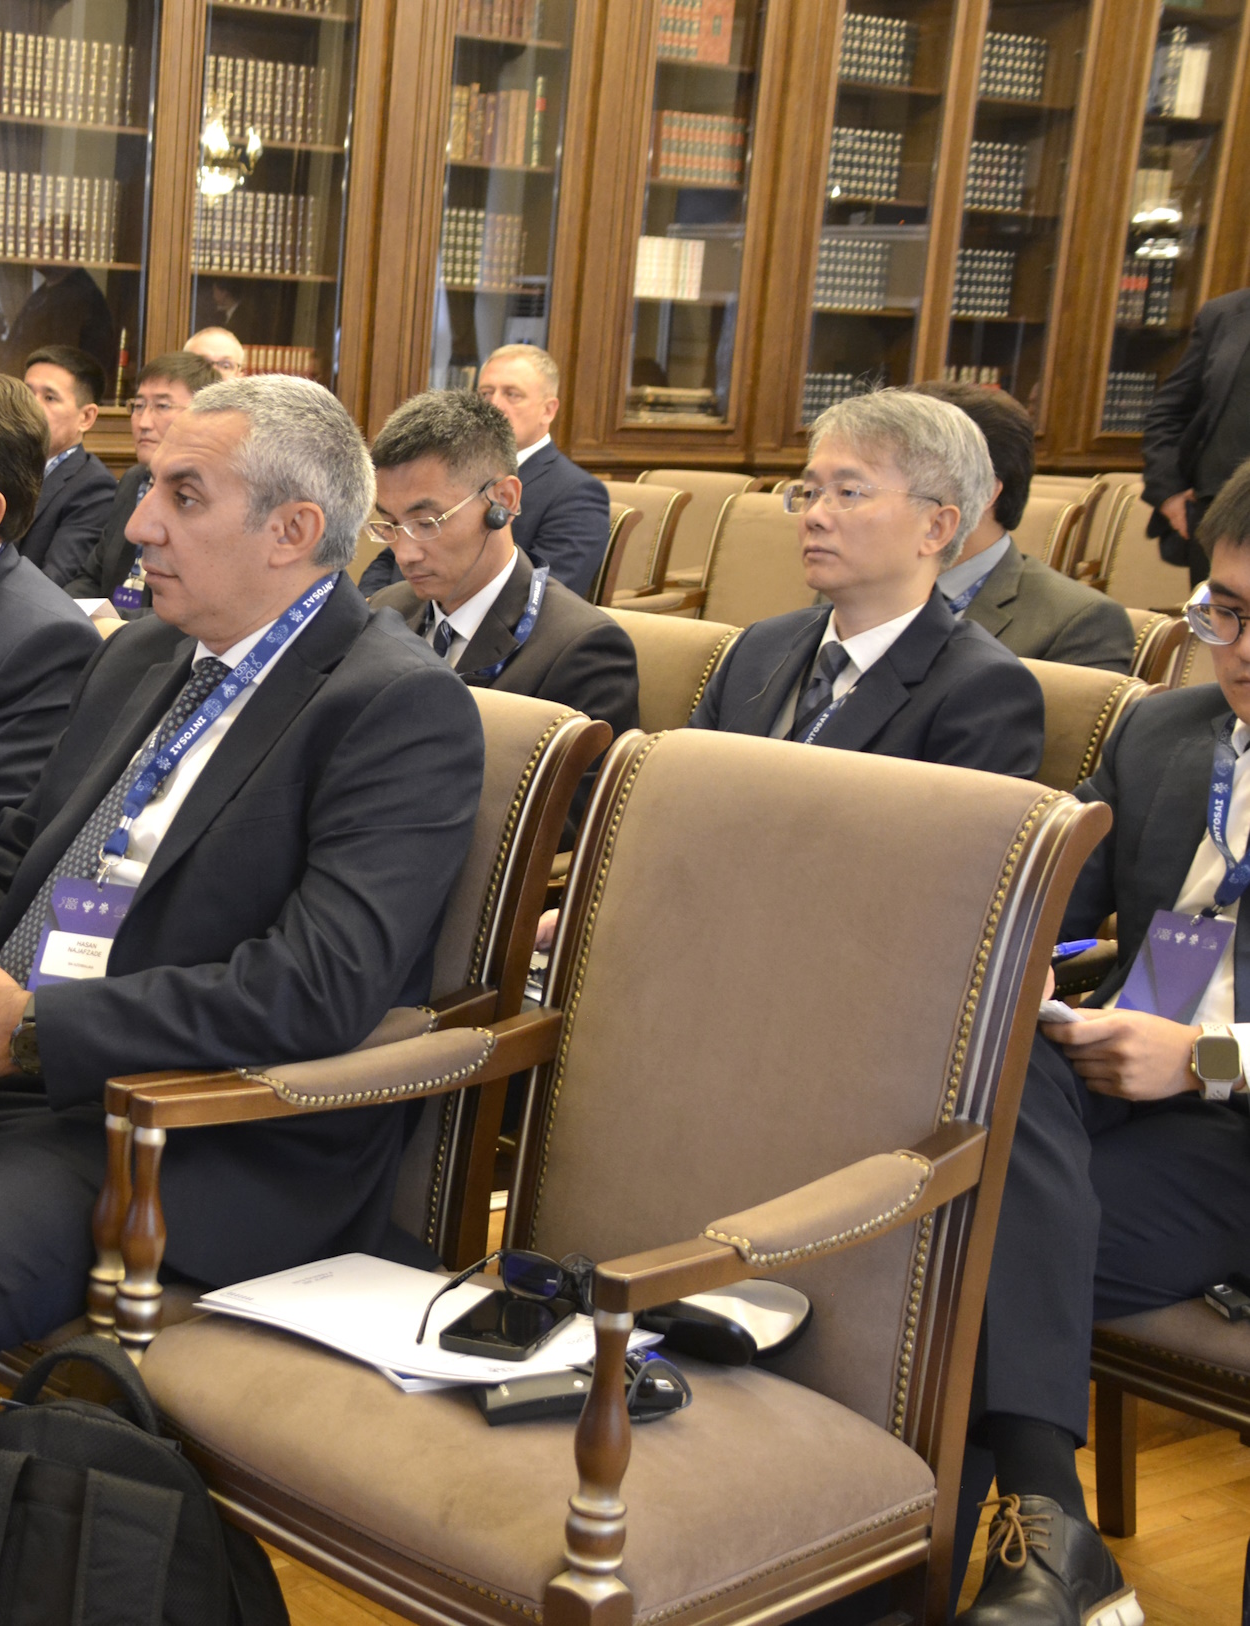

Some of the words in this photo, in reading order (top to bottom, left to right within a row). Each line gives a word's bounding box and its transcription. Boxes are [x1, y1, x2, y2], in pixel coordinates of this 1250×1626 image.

[302, 580, 334, 609] INTOSAI
[232, 660, 249, 678] KSDI
[240, 668, 258, 684] SDG
[169, 715, 207, 755] INTOSAI
[1214, 799, 1224, 843] INTOSAI
